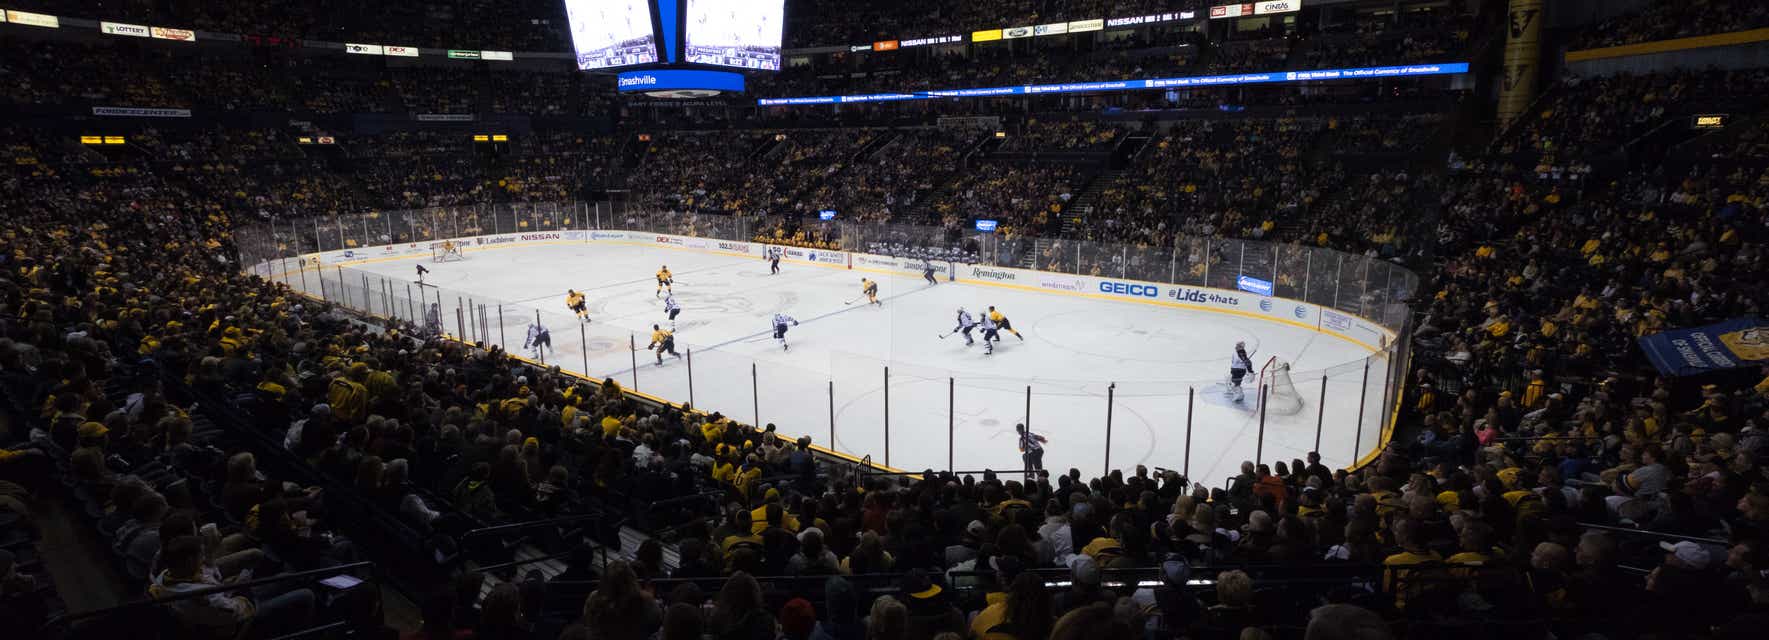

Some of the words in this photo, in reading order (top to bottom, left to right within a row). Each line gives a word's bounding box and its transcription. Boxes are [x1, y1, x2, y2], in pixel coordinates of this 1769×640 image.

[1107, 16, 1143, 26] NISSAN
[621, 74, 656, 87] Smashville
[520, 233, 560, 241] NISSAN
[972, 267, 1016, 281] Remington
[1100, 281, 1158, 297] GEICO
